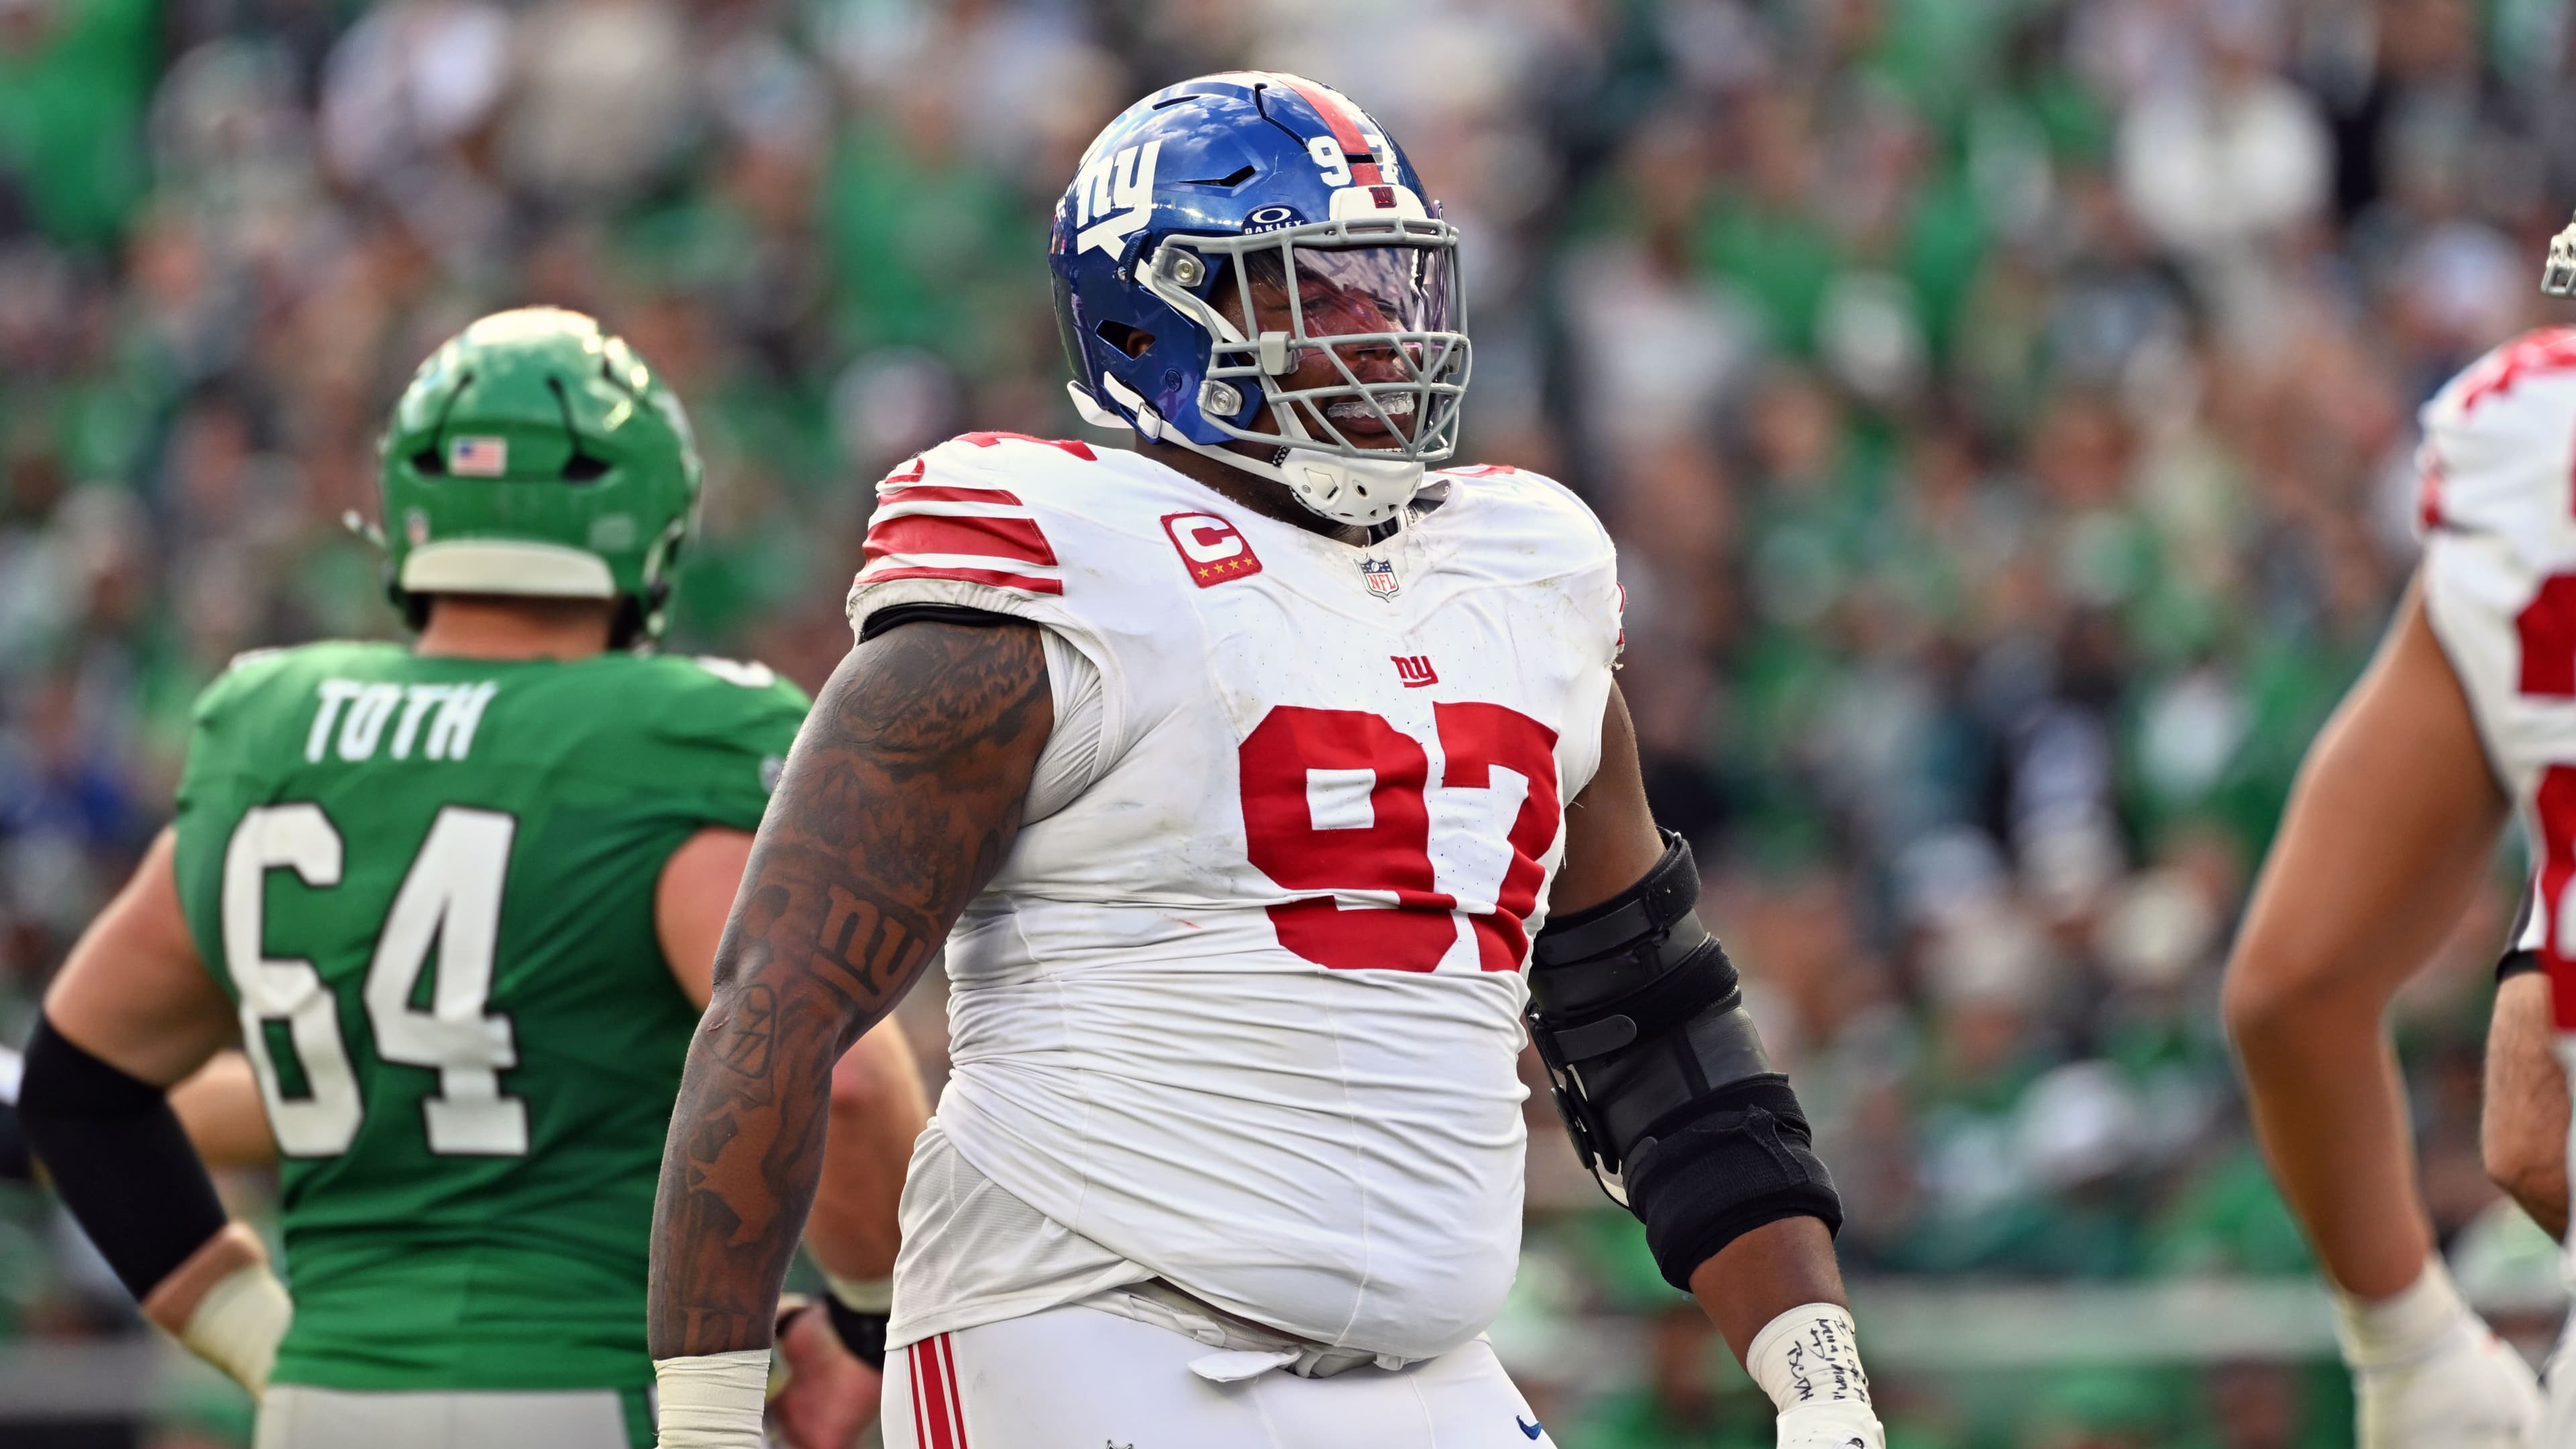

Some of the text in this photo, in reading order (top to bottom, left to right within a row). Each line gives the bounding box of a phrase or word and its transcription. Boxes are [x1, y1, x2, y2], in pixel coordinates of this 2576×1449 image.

[1244, 220, 1301, 235] OAKLEY
[1170, 515, 1243, 562] C
[1367, 574, 1396, 592] NFL
[304, 678, 499, 764] TOTH
[1238, 700, 1560, 973] 97
[220, 801, 530, 1158] 64
